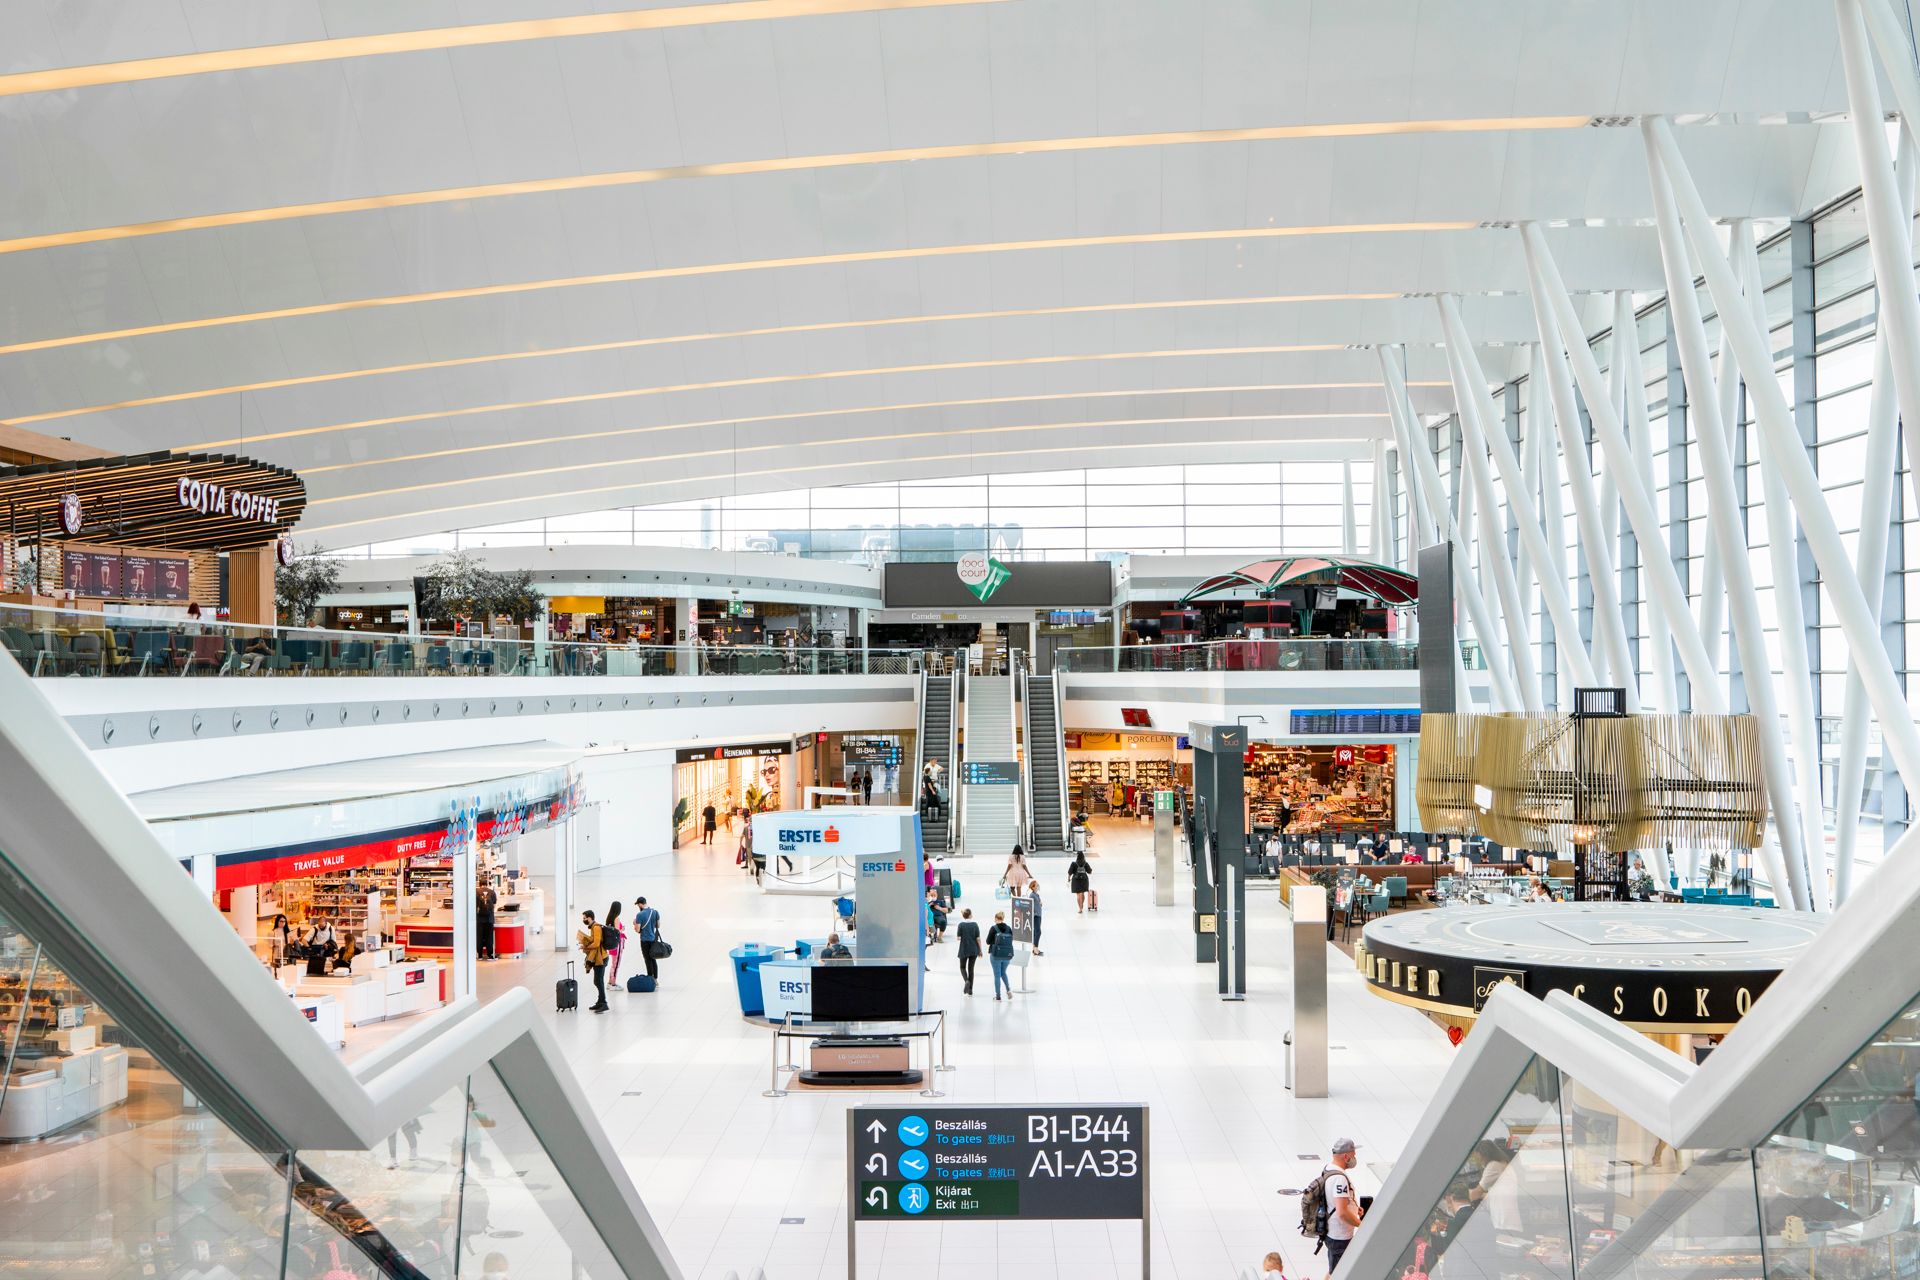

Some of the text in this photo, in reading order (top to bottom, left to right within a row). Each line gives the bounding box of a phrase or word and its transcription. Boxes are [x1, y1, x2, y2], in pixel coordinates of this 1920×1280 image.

[178, 477, 280, 523] COSTA COFFEE
[961, 559, 984, 567] food
[961, 569, 986, 577] court
[1127, 735, 1173, 743] PORCELAIN
[723, 749, 753, 757] HEINEMANN
[779, 830, 821, 842] ERSTE
[397, 840, 427, 853] DUTY FREE
[294, 855, 345, 871] TRAVEL VALUE
[862, 863, 893, 872] ERSTE
[1013, 917, 1020, 930] B
[1023, 918, 1032, 931] A
[936, 1120, 987, 1131] Beszállás
[1028, 1115, 1130, 1143] B1-B44
[936, 1134, 982, 1146] To gates
[987, 1134, 1015, 1144] 登机口
[936, 1154, 987, 1164] Beszállás
[1028, 1149, 1137, 1178] A1-A33
[936, 1168, 982, 1179] To gates
[988, 1168, 1015, 1178] 登机口
[936, 1186, 972, 1199] Kijárat
[1336, 1185, 1348, 1194] 54
[936, 1199, 956, 1209] Exit
[961, 1200, 979, 1209] 出口
